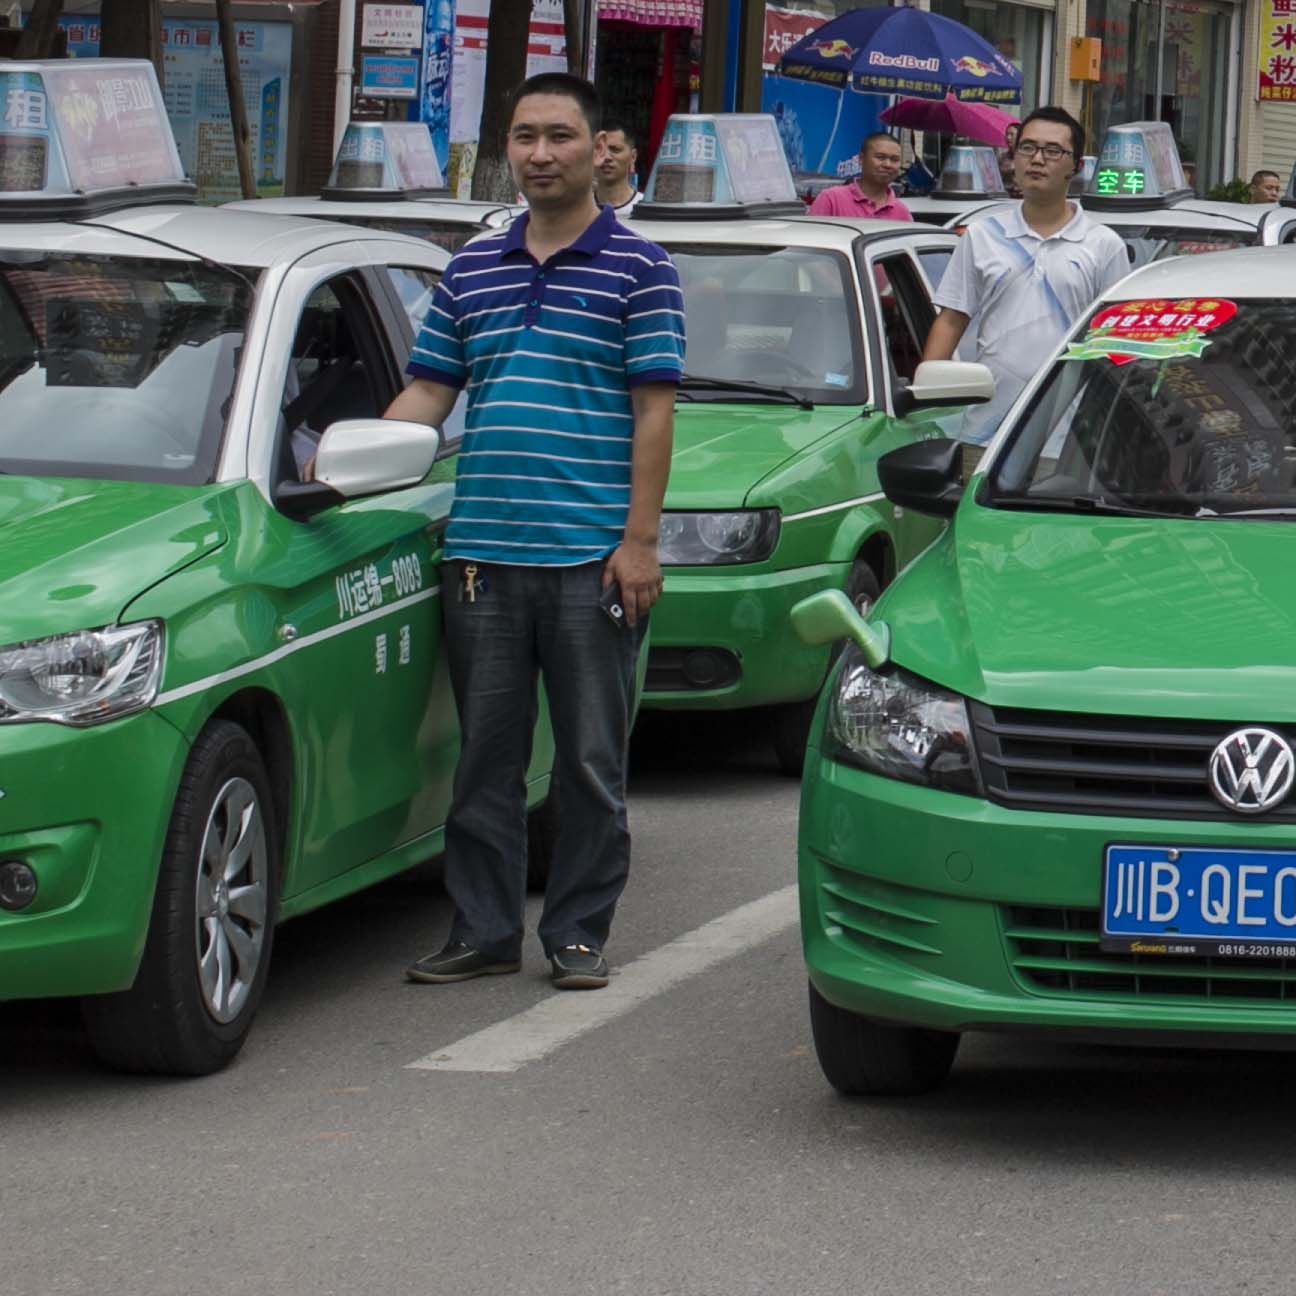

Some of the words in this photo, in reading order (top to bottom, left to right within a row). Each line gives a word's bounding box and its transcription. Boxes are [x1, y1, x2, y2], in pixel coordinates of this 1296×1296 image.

[658, 135, 717, 162] 出租
[1101, 143, 1143, 167] 出租
[1097, 168, 1144, 195] 空车
[1101, 313, 1216, 329] 创建文明行业
[1218, 943, 1296, 957] 0816-2201888
